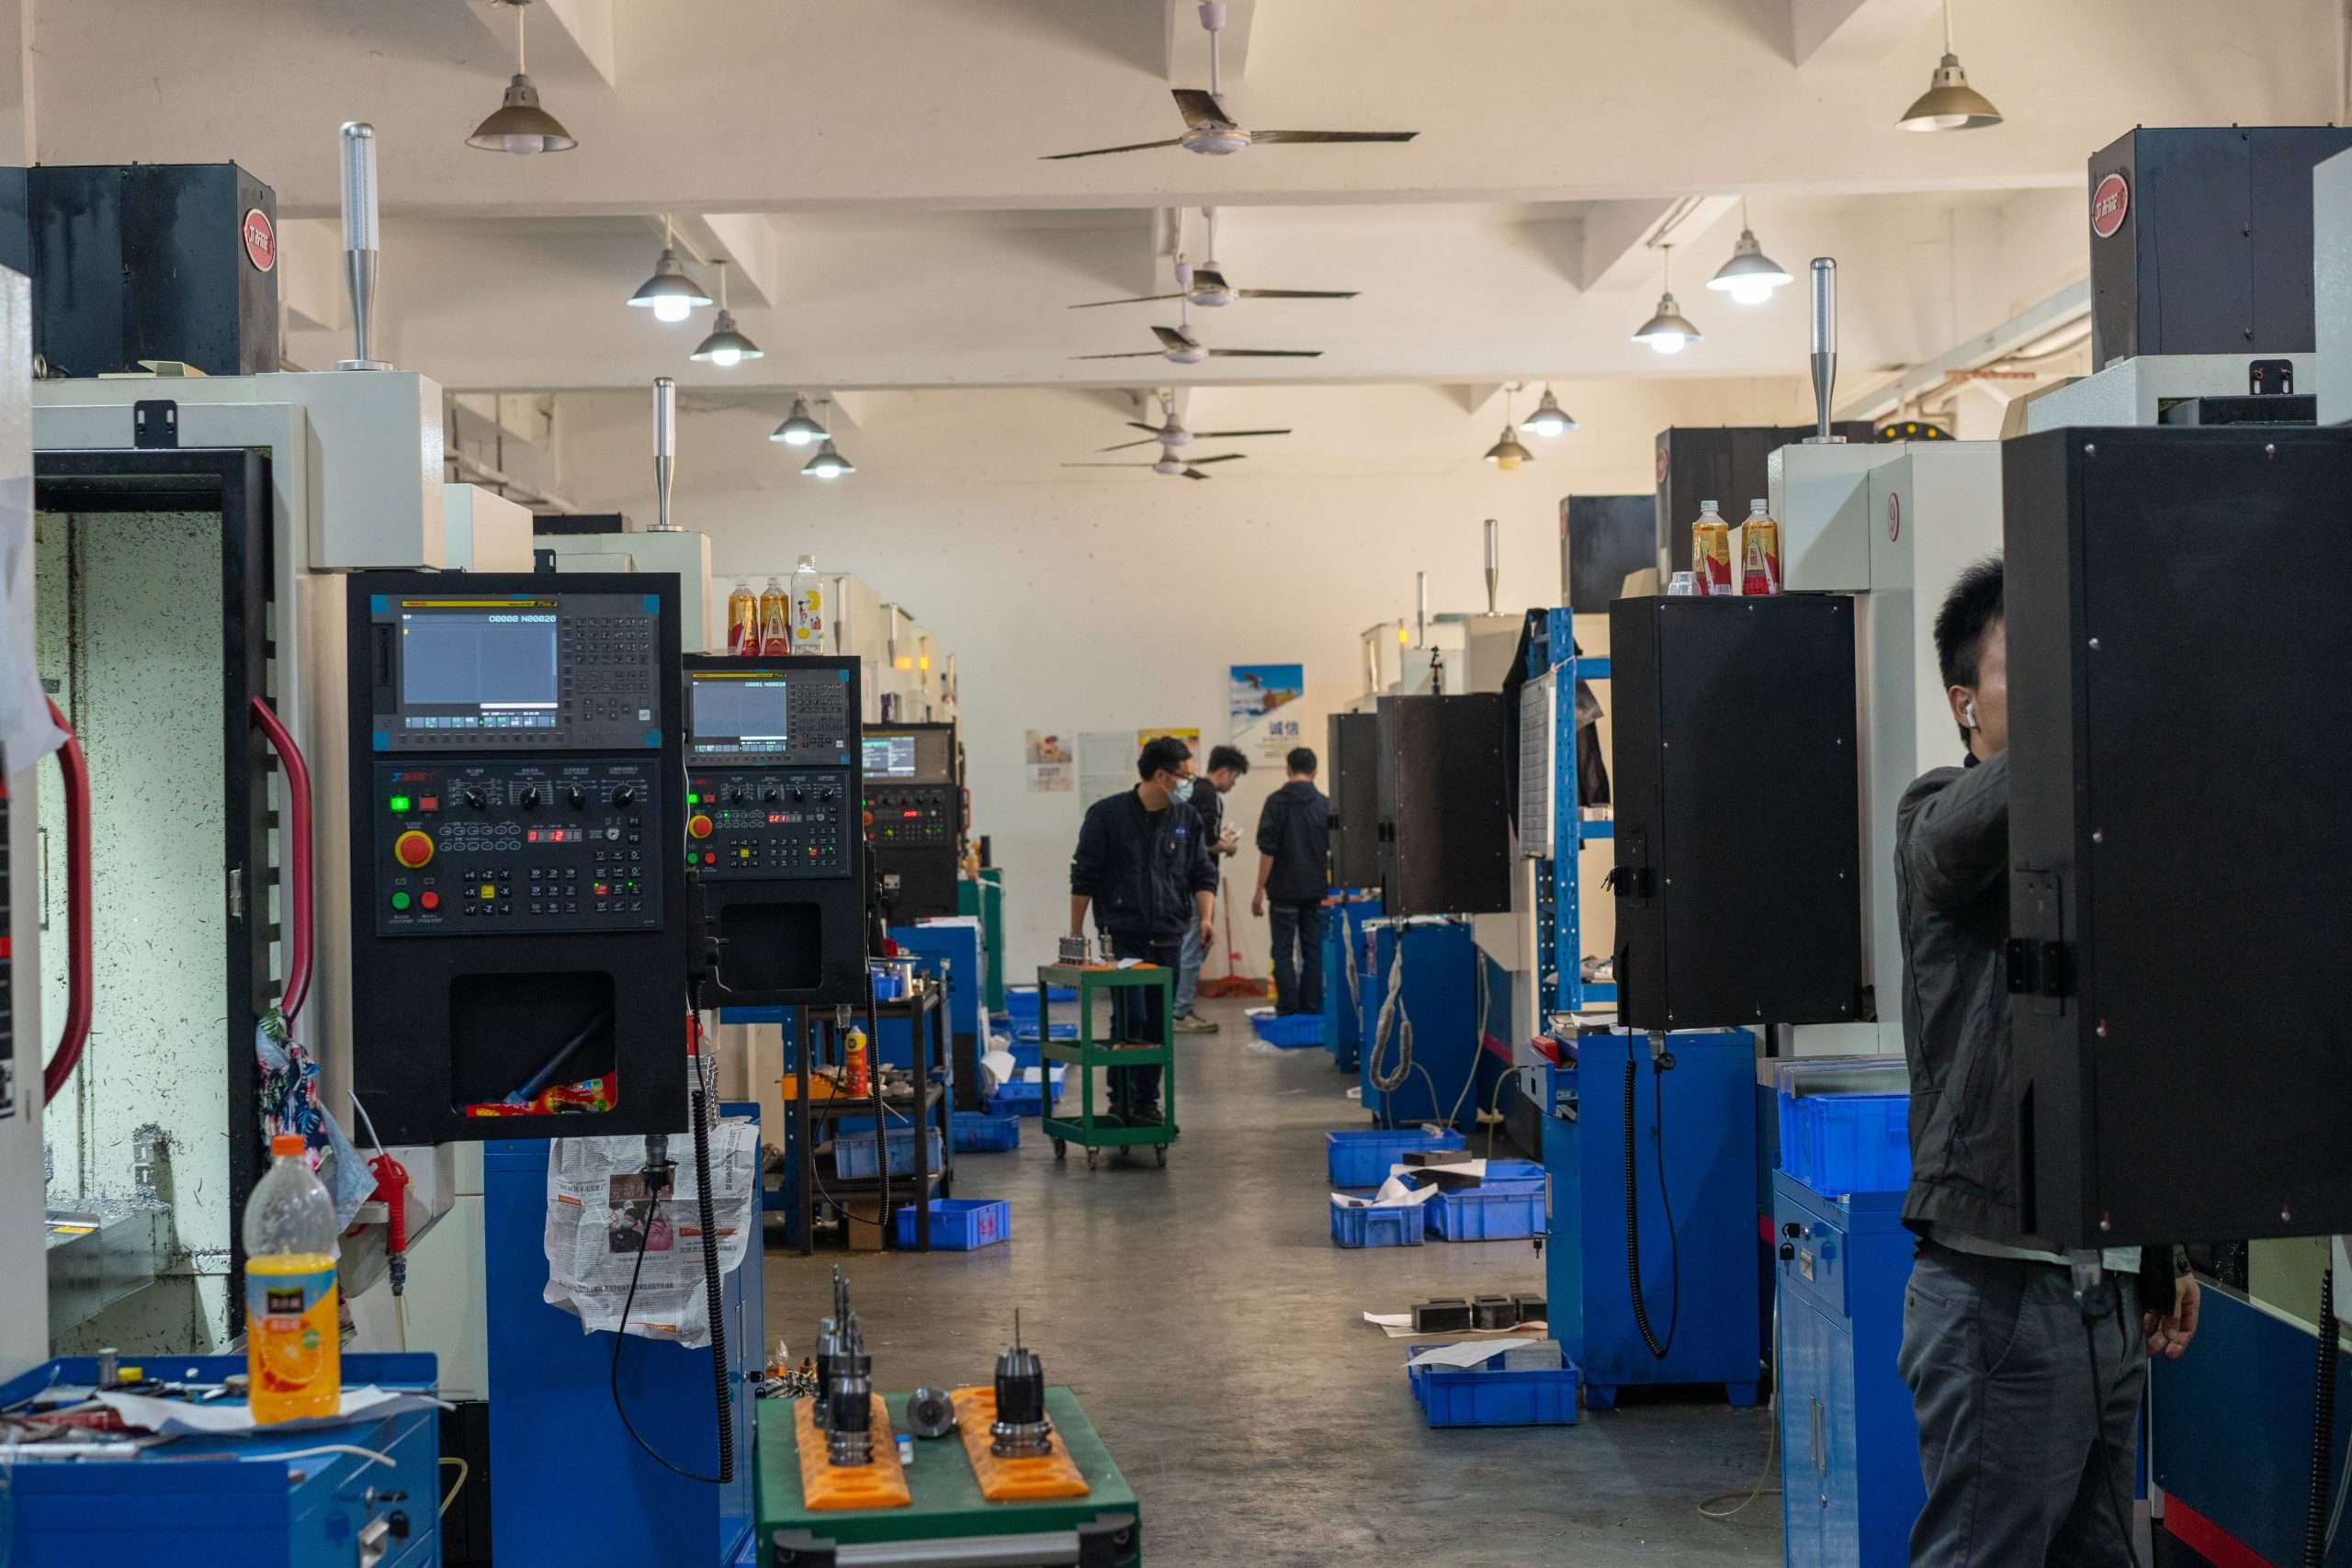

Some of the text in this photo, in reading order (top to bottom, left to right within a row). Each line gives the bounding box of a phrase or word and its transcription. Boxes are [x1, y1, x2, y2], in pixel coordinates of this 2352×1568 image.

[521, 615, 557, 623] N00020
[1269, 720, 1300, 736] 诚信
[482, 870, 492, 878] +Z
[465, 887, 475, 896] +X
[483, 905, 492, 913] -Z
